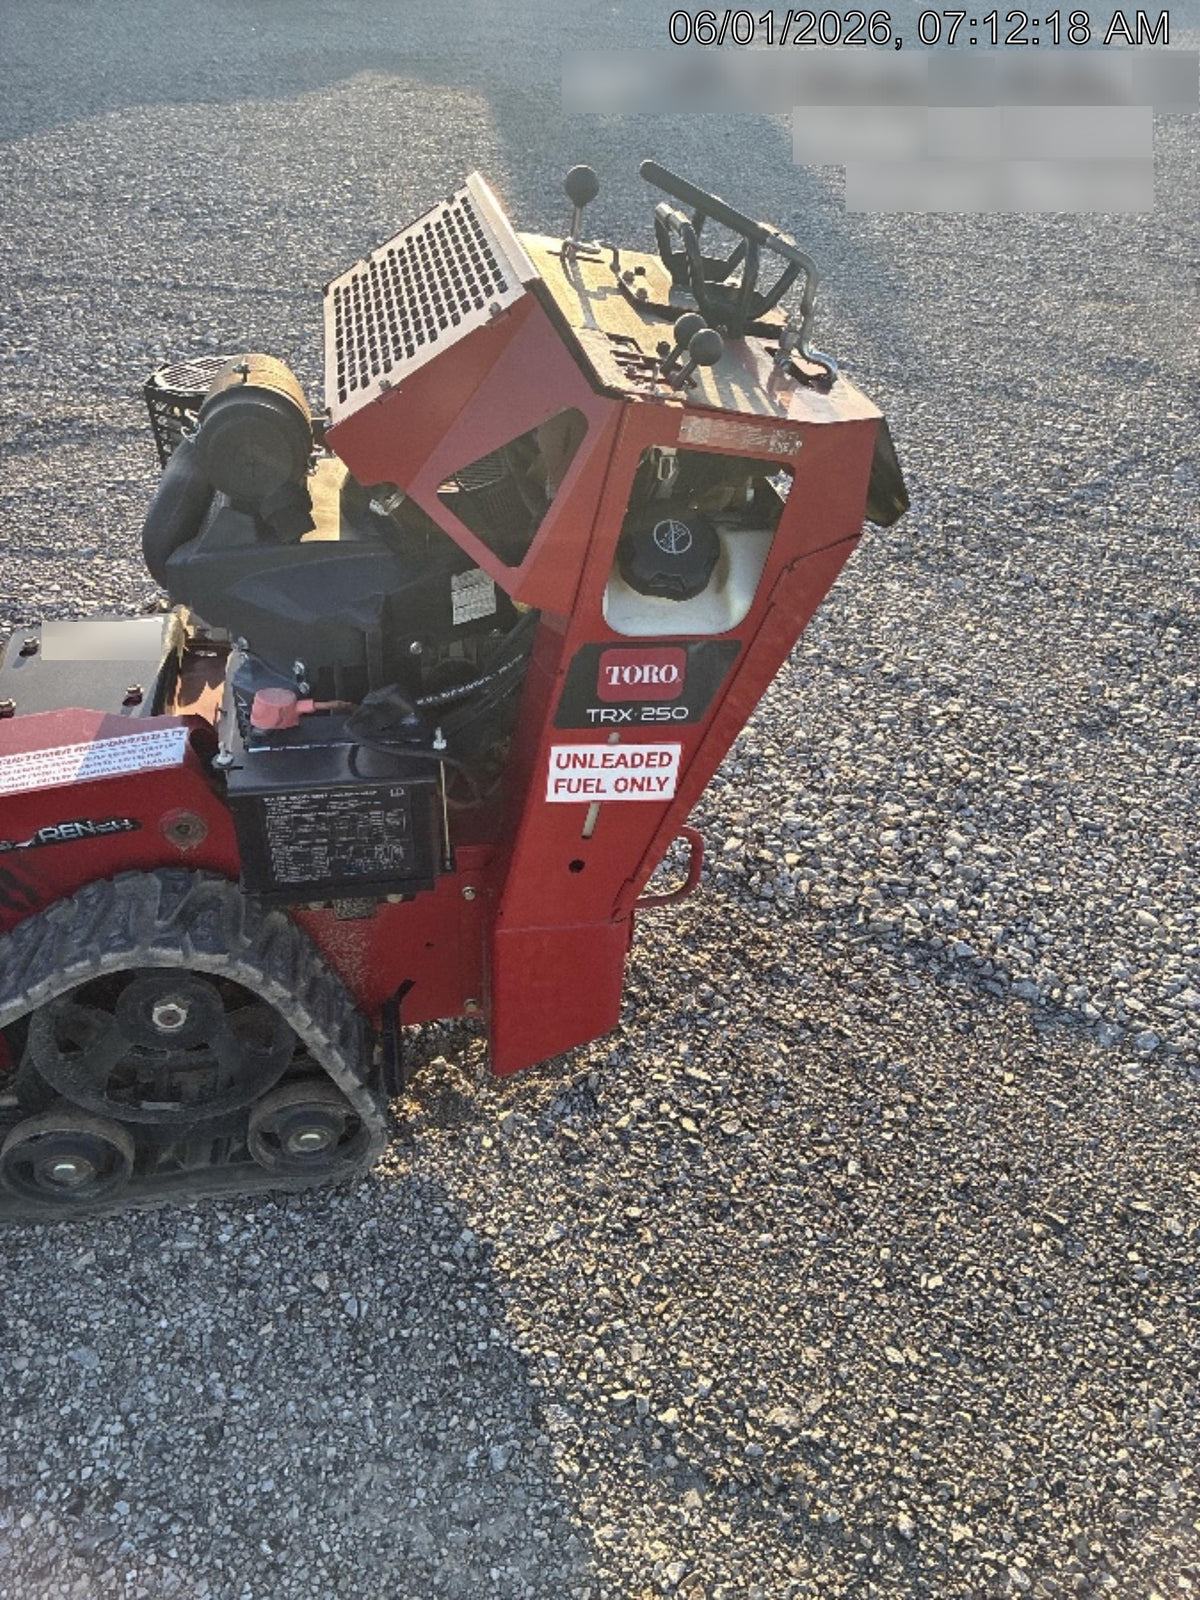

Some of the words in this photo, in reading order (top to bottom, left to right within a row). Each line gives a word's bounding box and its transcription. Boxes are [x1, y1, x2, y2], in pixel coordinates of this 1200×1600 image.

[605, 664, 678, 686] TORO
[555, 751, 673, 769] UNLEADED
[554, 777, 607, 794] FUEL
[613, 776, 670, 793] ONLY
